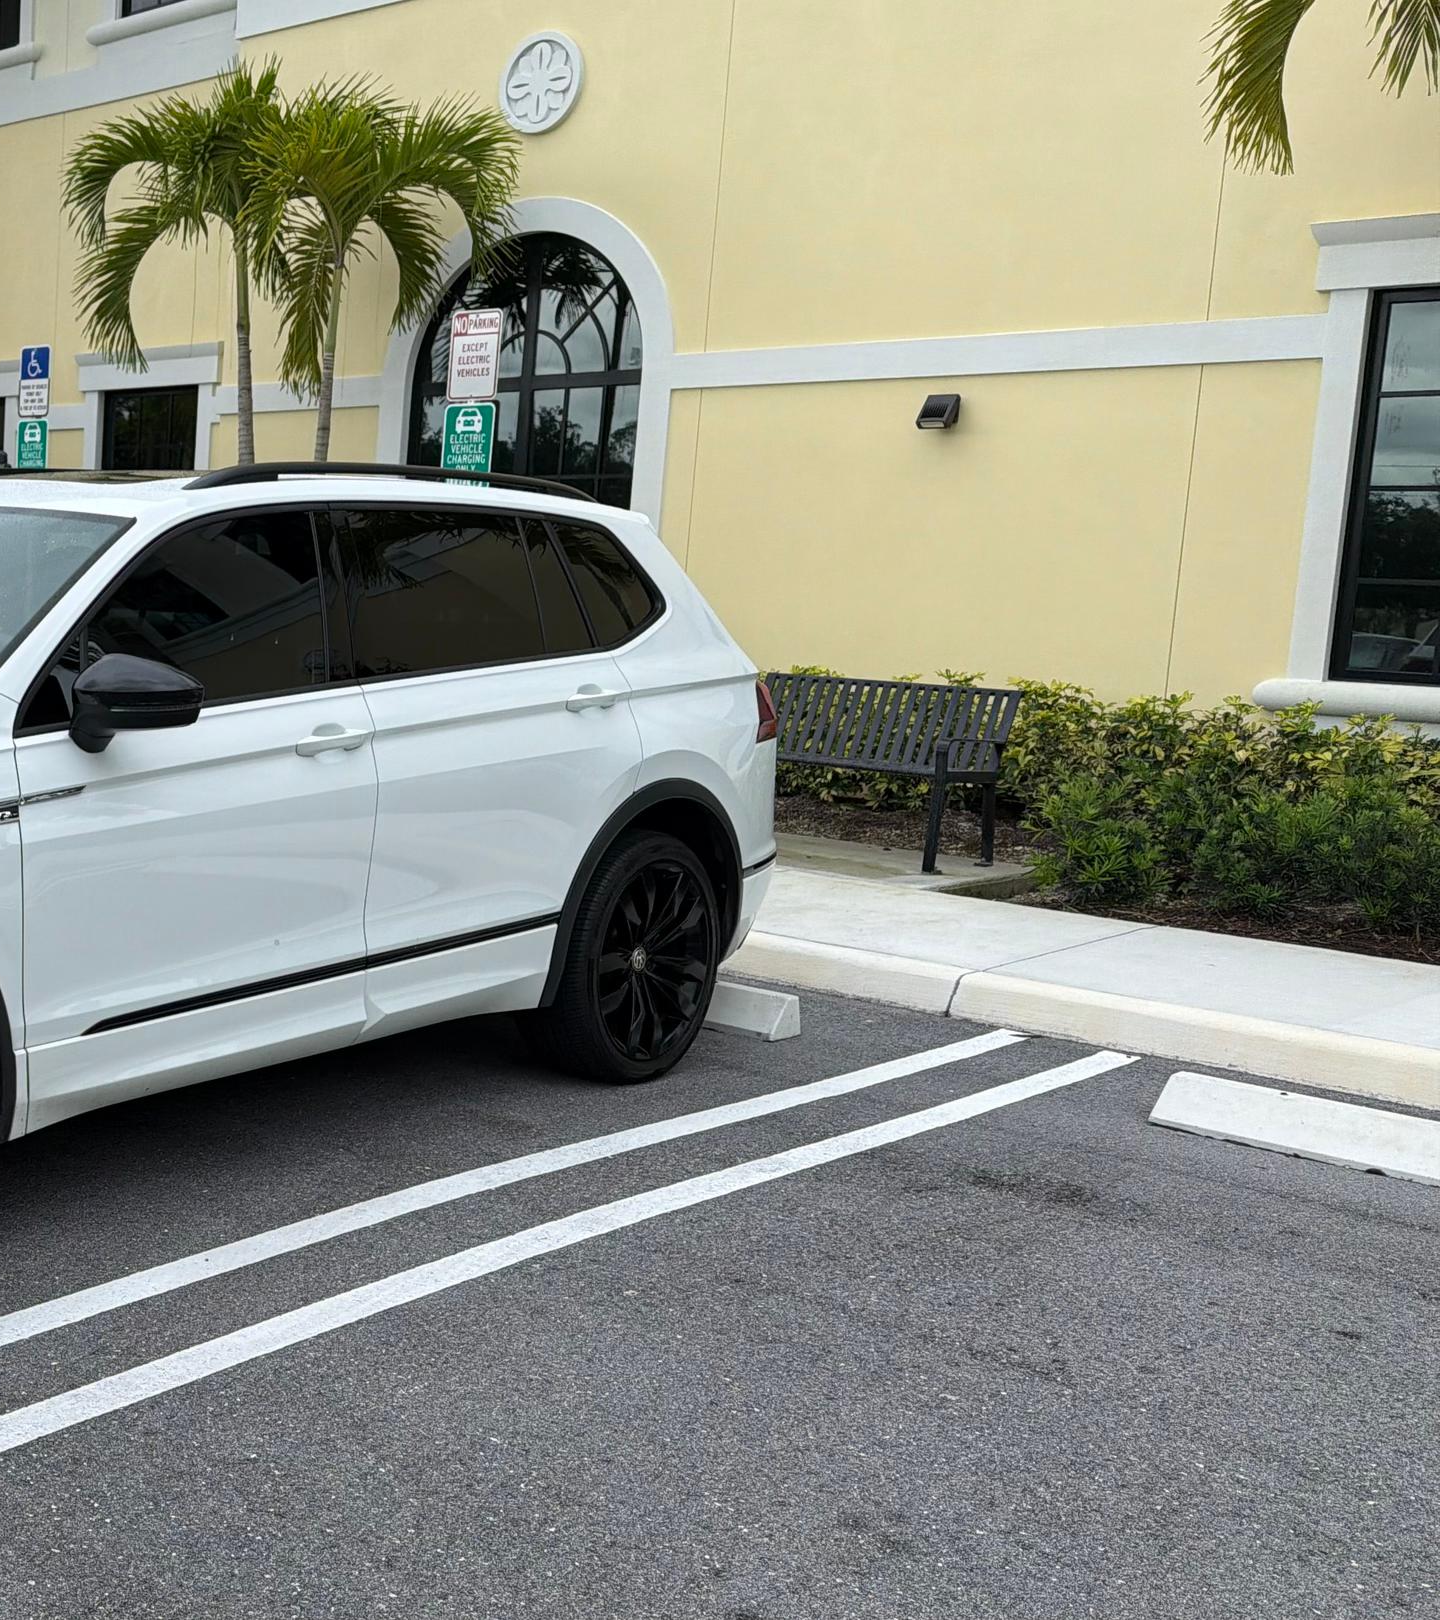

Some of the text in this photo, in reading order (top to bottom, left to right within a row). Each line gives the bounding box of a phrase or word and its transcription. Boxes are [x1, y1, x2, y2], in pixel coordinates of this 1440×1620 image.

[454, 316, 499, 334] NO PARKING
[461, 342, 489, 352] EXCEPT
[458, 355, 491, 365] ELECTRIC
[457, 367, 491, 377] VEHICLES
[449, 433, 486, 444] ELECTRIC
[451, 443, 483, 454] VEHICLE
[446, 454, 486, 464] CHARGING
